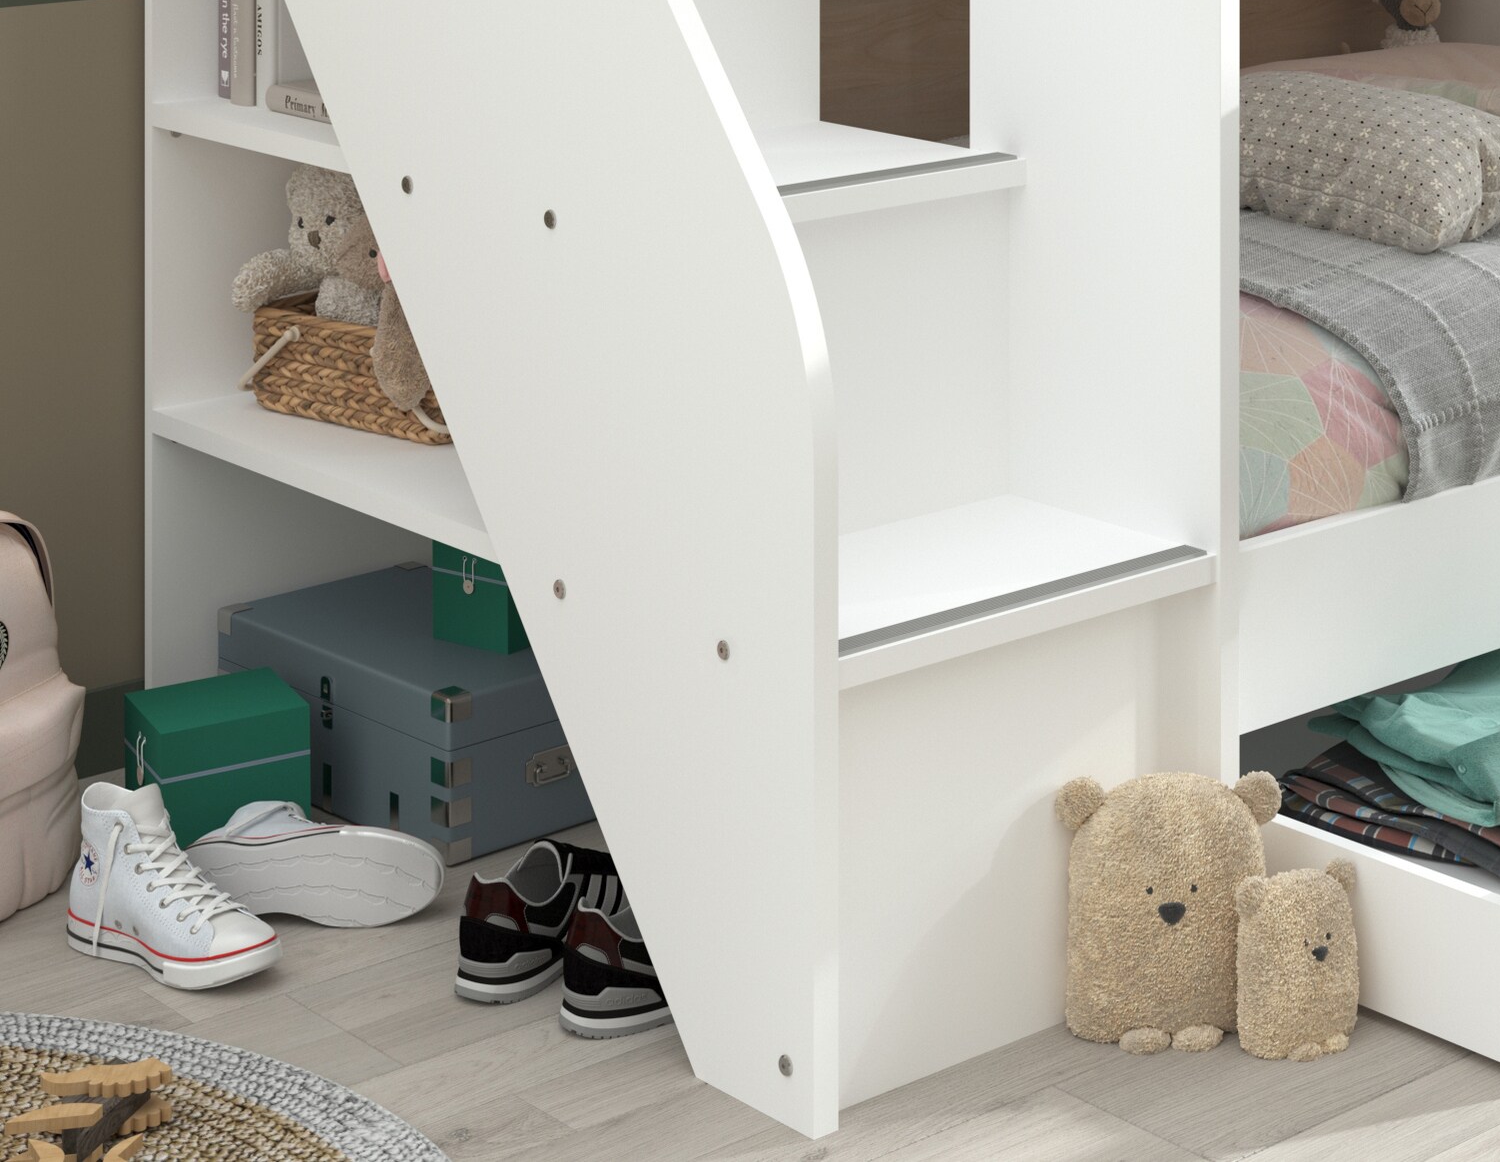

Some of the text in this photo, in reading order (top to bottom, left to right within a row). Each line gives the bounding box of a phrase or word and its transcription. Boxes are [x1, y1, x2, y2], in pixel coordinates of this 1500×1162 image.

[221, 13, 230, 34] the
[220, 38, 228, 58] rye
[285, 95, 316, 118] Primary
